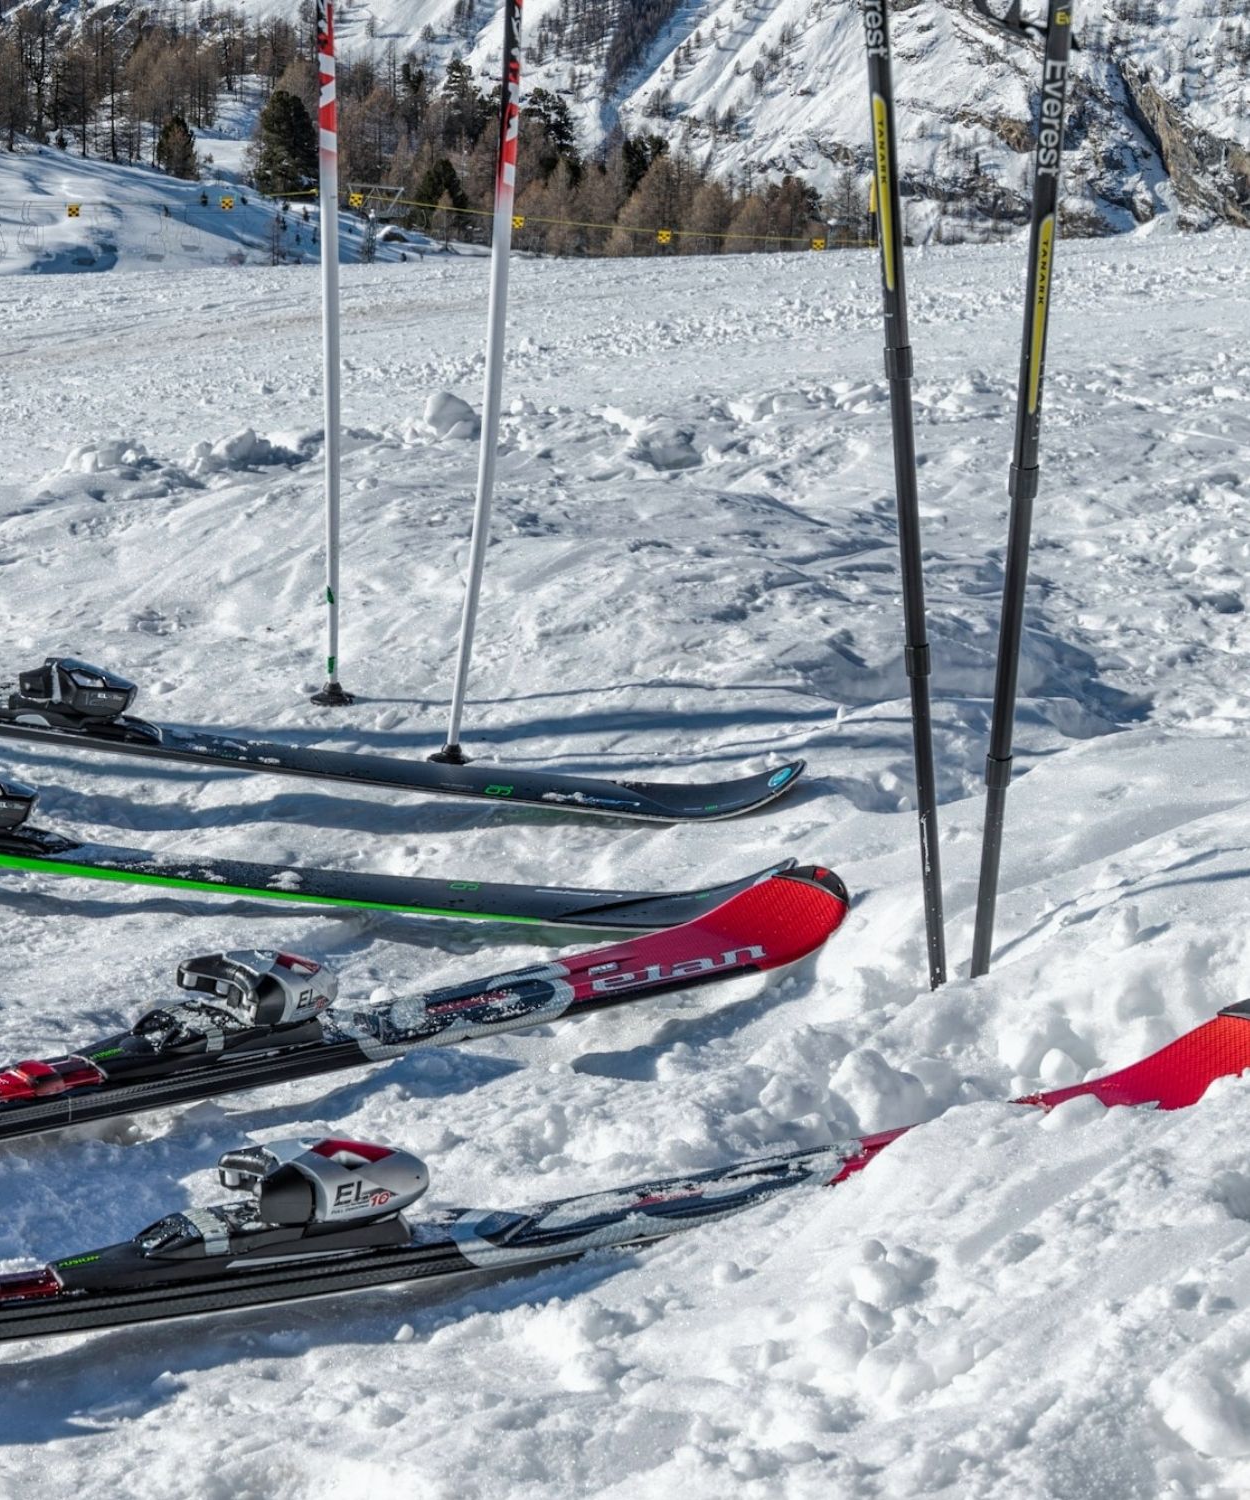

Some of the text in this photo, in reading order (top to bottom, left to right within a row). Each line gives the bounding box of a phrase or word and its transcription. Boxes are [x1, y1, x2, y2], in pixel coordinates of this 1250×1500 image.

[1036, 59, 1069, 177] Everest
[592, 944, 767, 991] elan
[334, 1180, 391, 1208] EL 10
